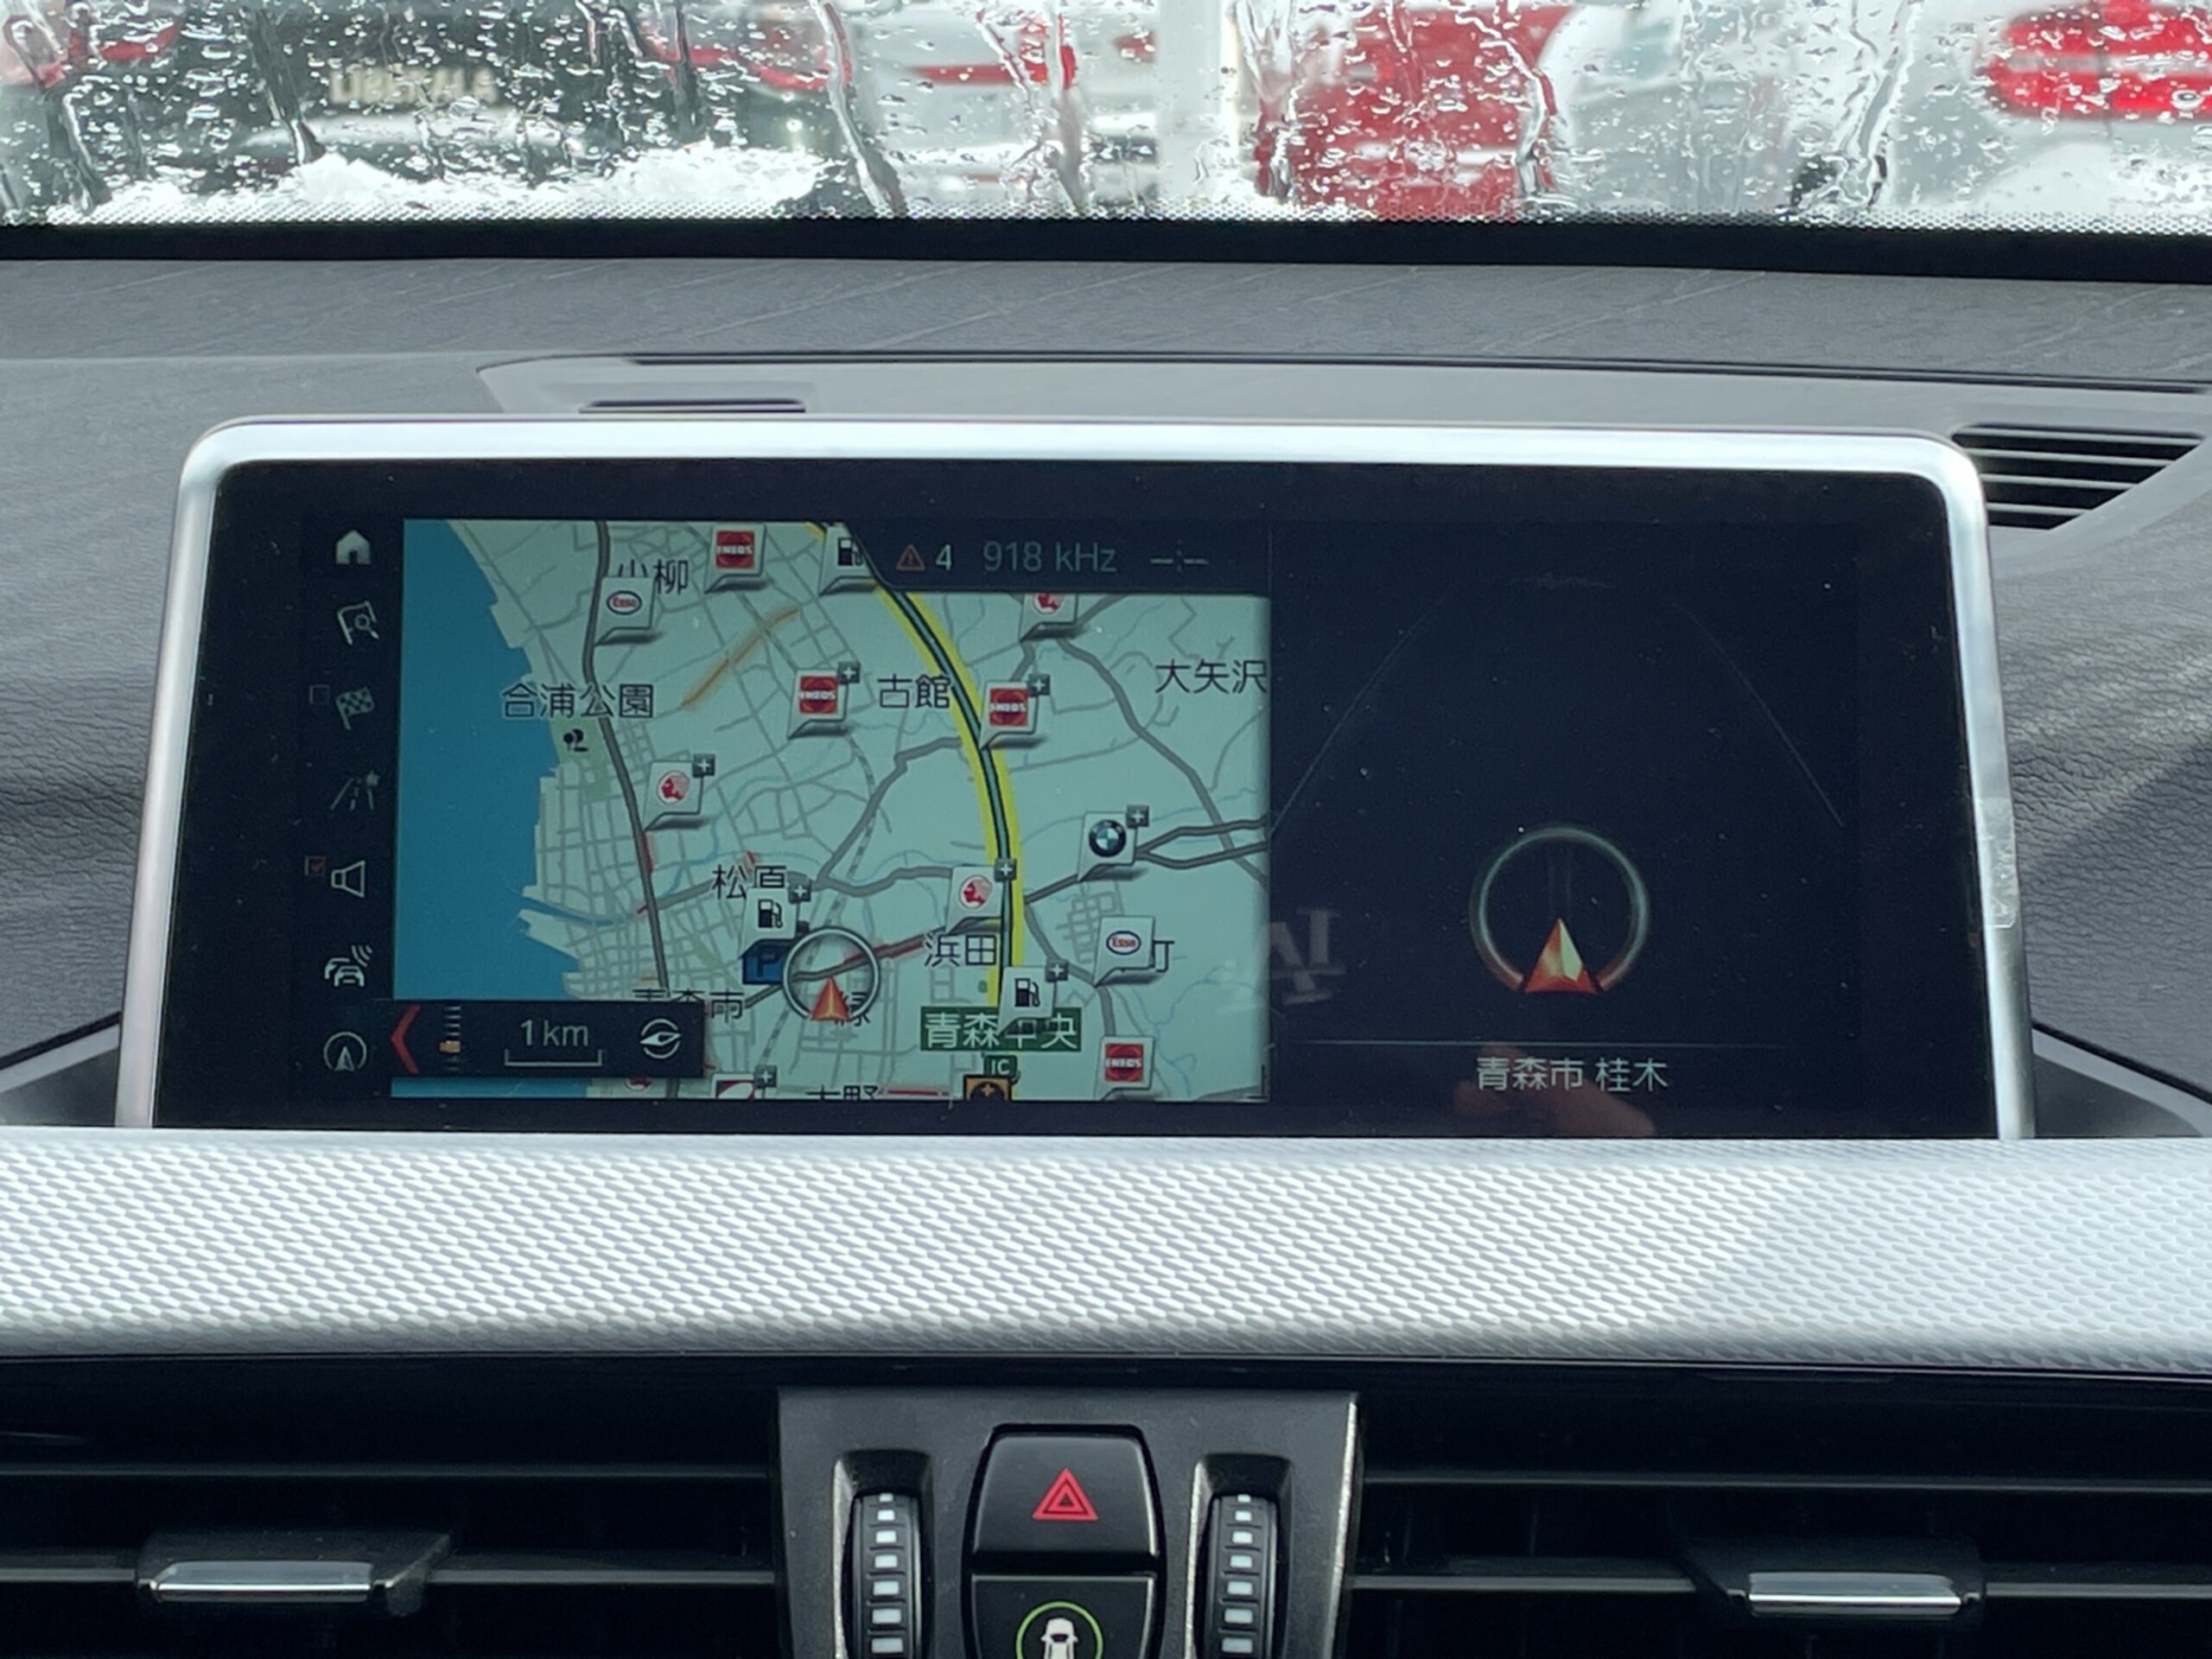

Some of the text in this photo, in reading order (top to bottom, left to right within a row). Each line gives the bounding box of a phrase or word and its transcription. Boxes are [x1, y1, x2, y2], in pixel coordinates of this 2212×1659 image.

[935, 544, 952, 571] 4
[982, 542, 1118, 573] 918 kHz
[877, 673, 950, 709] 古館
[1154, 658, 1268, 694] 大矢沢
[501, 683, 654, 719] 合浦公園
[924, 933, 997, 967] 浜田
[520, 1020, 589, 1047] 1 km
[991, 1058, 1010, 1075] IC
[1477, 1057, 1669, 1092] 青森市 桂木
